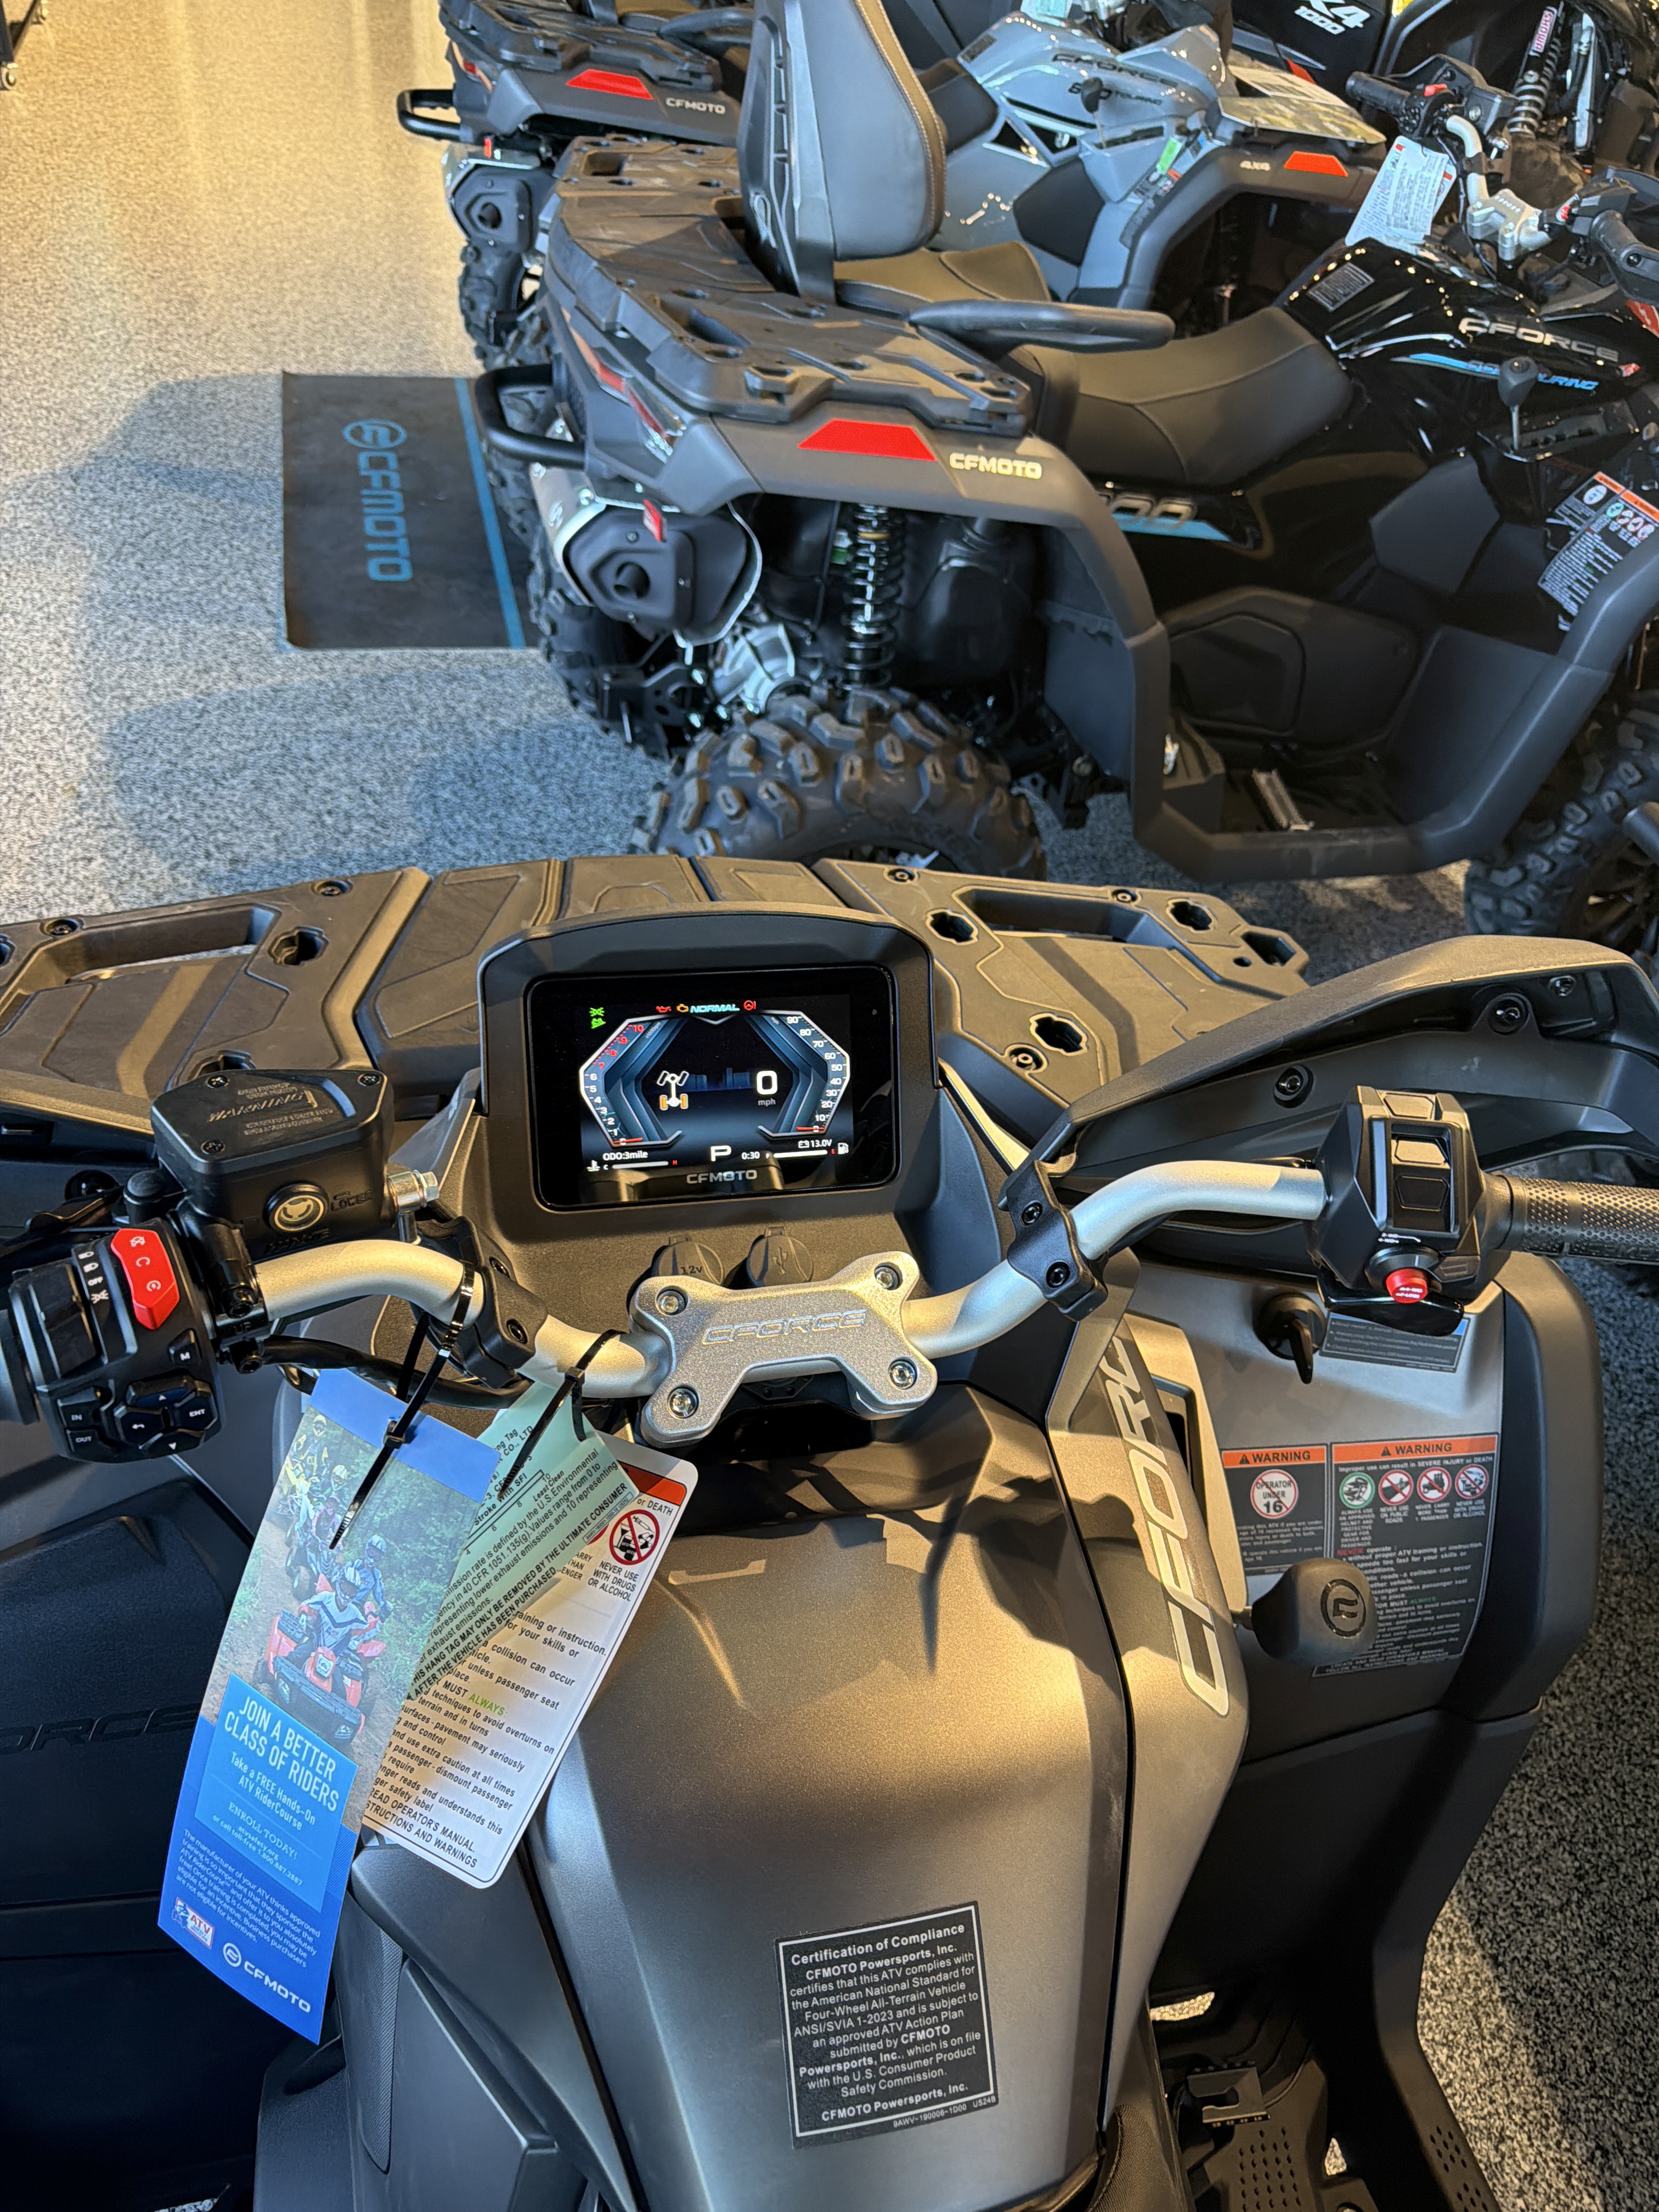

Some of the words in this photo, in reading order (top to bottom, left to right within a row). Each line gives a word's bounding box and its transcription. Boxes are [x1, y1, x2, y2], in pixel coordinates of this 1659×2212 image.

[1294, 5, 1346, 35] 1000
[1068, 82, 1113, 100] 60
[665, 97, 725, 115] CFMOTO
[1458, 317, 1619, 363] CFORCE
[949, 452, 1042, 479] CFMOTO
[358, 450, 413, 582] CFMOTO
[690, 1003, 740, 1013] NORMAL
[633, 1024, 645, 1033] 10
[786, 1016, 799, 1024] 90
[620, 1036, 628, 1045] 9
[799, 1028, 812, 1036] 80
[610, 1049, 618, 1057] 8
[812, 1040, 824, 1048] 70
[590, 1073, 598, 1081] 6
[598, 1062, 605, 1070] 7
[590, 1085, 597, 1093] 5
[756, 1070, 778, 1095] 0
[758, 1098, 776, 1107] mph
[821, 1101, 833, 1109] 20
[607, 1117, 615, 1125] 2
[710, 1145, 732, 1161] P
[810, 1139, 832, 1147] 13.0V
[602, 1150, 648, 1161] ODO:3mile
[741, 1151, 760, 1160] 0:30
[686, 1169, 758, 1184] CFMOTO
[87, 1276, 104, 1286] OFF
[702, 1308, 867, 1346] CFORCE
[179, 1351, 190, 1361] M
[188, 1408, 206, 1417] ENT
[75, 1435, 93, 1443] OUT
[1395, 1442, 1452, 1455] WARNING
[1251, 1450, 1311, 1463] WARNING
[1254, 1480, 1293, 1491] OPERATOR
[1263, 1490, 1285, 1499] UNDER
[647, 1500, 674, 1516] DEATH
[1263, 1500, 1284, 1515] 16
[1098, 1335, 1229, 1717] CFORC
[424, 1651, 446, 1673] HANG
[444, 1638, 461, 1654] TAG
[459, 1624, 475, 1643] MAY
[475, 1608, 493, 1628] ONLY
[492, 1599, 505, 1612] BE
[503, 1570, 537, 1604] REMOVED
[535, 1560, 546, 1573] BY
[544, 1547, 561, 1563] THE
[558, 1517, 591, 1551] ULTIMATE
[590, 1482, 627, 1521] CONSUMER
[592, 1568, 611, 1582] WITH
[611, 1576, 636, 1592] DRUGS
[599, 1560, 623, 1576] NEVER
[624, 1570, 639, 1582] USE
[588, 1577, 599, 1588] OR
[599, 1582, 631, 1602] ALCOHOL
[414, 1673, 439, 1697] AFTER
[436, 1660, 453, 1676] THE
[450, 1634, 483, 1664] VEHICLE
[481, 1621, 497, 1638] HAS
[495, 1604, 516, 1625] BEEN
[442, 1680, 469, 1697] MUST
[239, 1696, 272, 1733] JOIN
[270, 1717, 284, 1743] A
[283, 1727, 336, 1782] BETTER
[224, 1711, 268, 1757] CLASS
[268, 1745, 289, 1770] OF
[288, 1759, 339, 1812] RIDERS
[231, 1751, 248, 1773] Take
[249, 1769, 255, 1779] a
[256, 1771, 276, 1795] FREE
[276, 1787, 315, 1825] Hands-On
[238, 1775, 255, 1793] ATV
[255, 1786, 302, 1831] RiderCourse
[220, 1821, 232, 1832] call
[232, 1829, 257, 1852] toll-free
[228, 1802, 262, 1834] ENROLL
[263, 1829, 297, 1860] TODAY!
[391, 1799, 440, 1832] OPERATOR'S
[440, 1826, 475, 1853] MANUAL.
[238, 1826, 279, 1861] atvsafety.org
[414, 1828, 433, 1843] AND
[433, 1837, 477, 1868] WARNINGS
[190, 1914, 211, 1934] ATV
[791, 1944, 873, 1966] Certification
[876, 1938, 889, 1951] of
[891, 1925, 965, 1948] Compliance
[806, 1962, 857, 1980] CFMOTO
[860, 1949, 935, 1971] Powersports,
[936, 1944, 957, 1955] Inc.
[789, 1982, 834, 1997] certifies
[836, 1976, 858, 1989] that
[859, 1973, 879, 1985] this
[881, 1967, 902, 1980] ATV
[905, 1959, 952, 1976] complies
[953, 1952, 974, 1965] with
[244, 1961, 311, 2013] CFMOTO
[791, 2000, 809, 2010] the
[811, 1990, 863, 2007] American
[865, 1979, 910, 1997] National
[912, 1968, 960, 1987] Standard
[961, 1966, 975, 1976] for
[805, 2001, 869, 2022] Four-Wheel
[871, 1990, 926, 2010] All-Terrain
[928, 1982, 966, 1997] Vehicle
[794, 2017, 855, 2038] ANSI/SVIA
[856, 2010, 894, 2026] 1-2023
[896, 2005, 916, 2018] and
[918, 2004, 927, 2013] is
[929, 1994, 967, 2011] subject
[968, 1992, 978, 2001] to
[812, 2038, 826, 2048] an
[829, 2026, 880, 2046] approved
[881, 2021, 903, 2035] ATV
[905, 2016, 939, 2030] Action
[940, 2009, 964, 2022] Plan
[830, 2039, 883, 2058] submitted
[885, 2038, 898, 2049] by
[900, 2024, 950, 2044] CFMOTO
[799, 2056, 877, 2078] Powersports,
[879, 2049, 904, 2064] Inc.,
[906, 2042, 937, 2057] which
[939, 2040, 949, 2049] is
[950, 2036, 963, 2046] on
[965, 2032, 981, 2042] file
[807, 2077, 830, 2090] with
[832, 2075, 850, 2086] the
[853, 2068, 876, 2081] U.S.
[879, 2056, 934, 2076] Consumer
[935, 2045, 976, 2064] Product
[840, 2080, 877, 2101] Safety
[878, 2068, 947, 2090] Commission.
[821, 2103, 872, 2121] CFMOTO
[873, 2089, 946, 2112] Powersports,
[948, 2083, 968, 2094] Inc.
